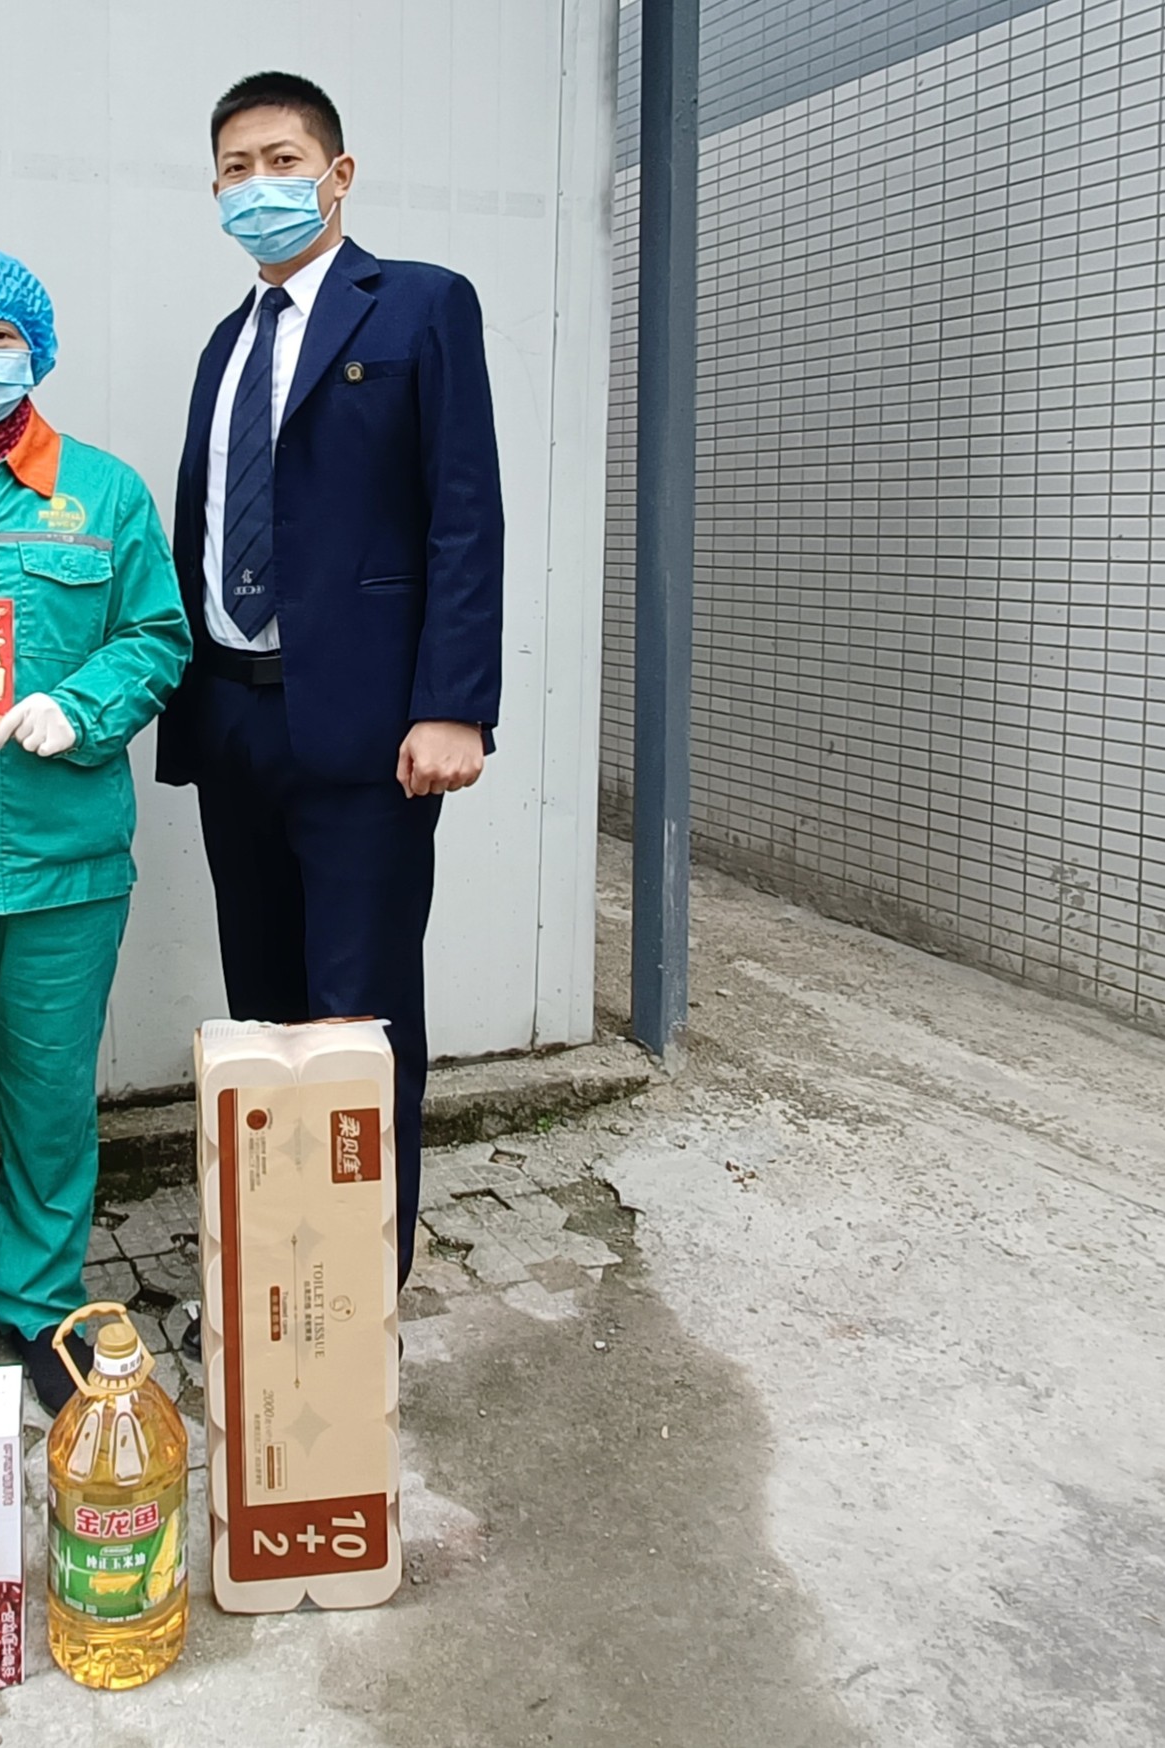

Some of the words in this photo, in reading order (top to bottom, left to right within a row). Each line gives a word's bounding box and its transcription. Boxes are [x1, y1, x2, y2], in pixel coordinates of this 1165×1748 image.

[313, 1262, 324, 1309] TOILET
[314, 1313, 326, 1359] TISSUE
[75, 1501, 159, 1538] 金龙鱼
